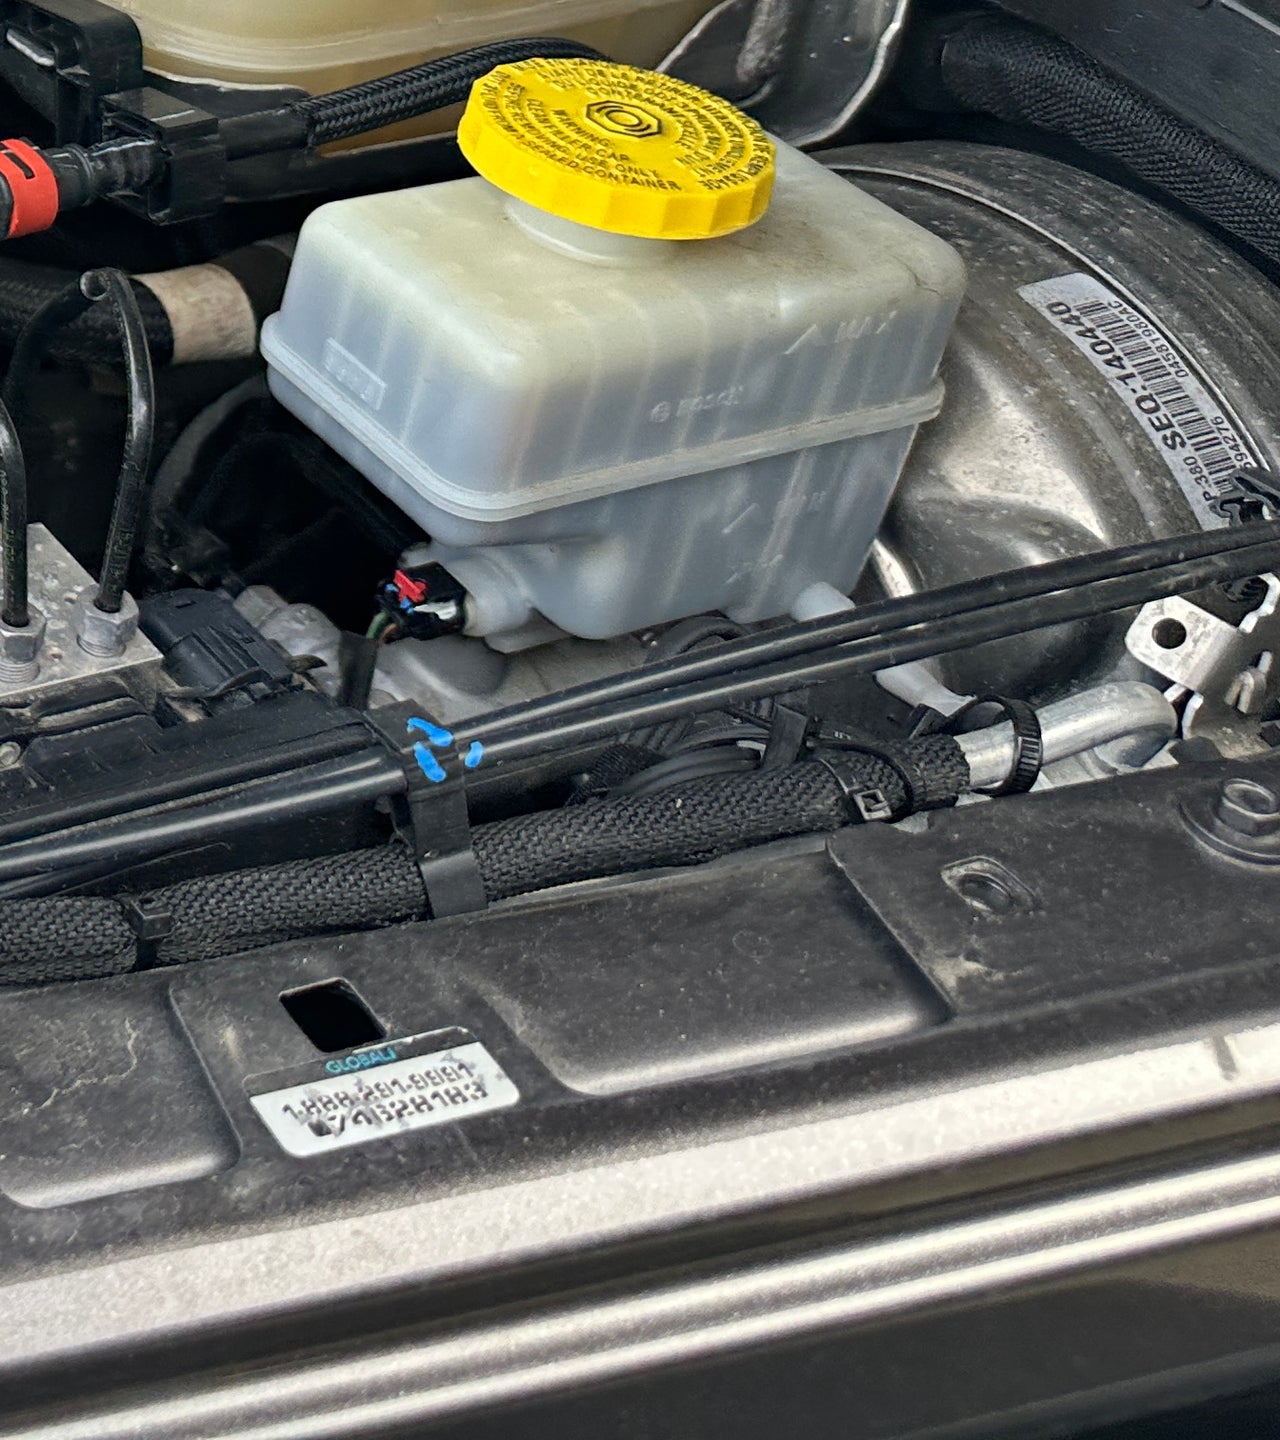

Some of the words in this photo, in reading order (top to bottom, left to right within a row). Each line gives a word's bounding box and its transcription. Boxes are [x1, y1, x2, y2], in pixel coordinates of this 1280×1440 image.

[581, 165, 682, 190] CONTAINER
[615, 163, 661, 179] ONLY
[1107, 300, 1189, 379] 04581980AC
[1046, 300, 1188, 451] SEQ:140440
